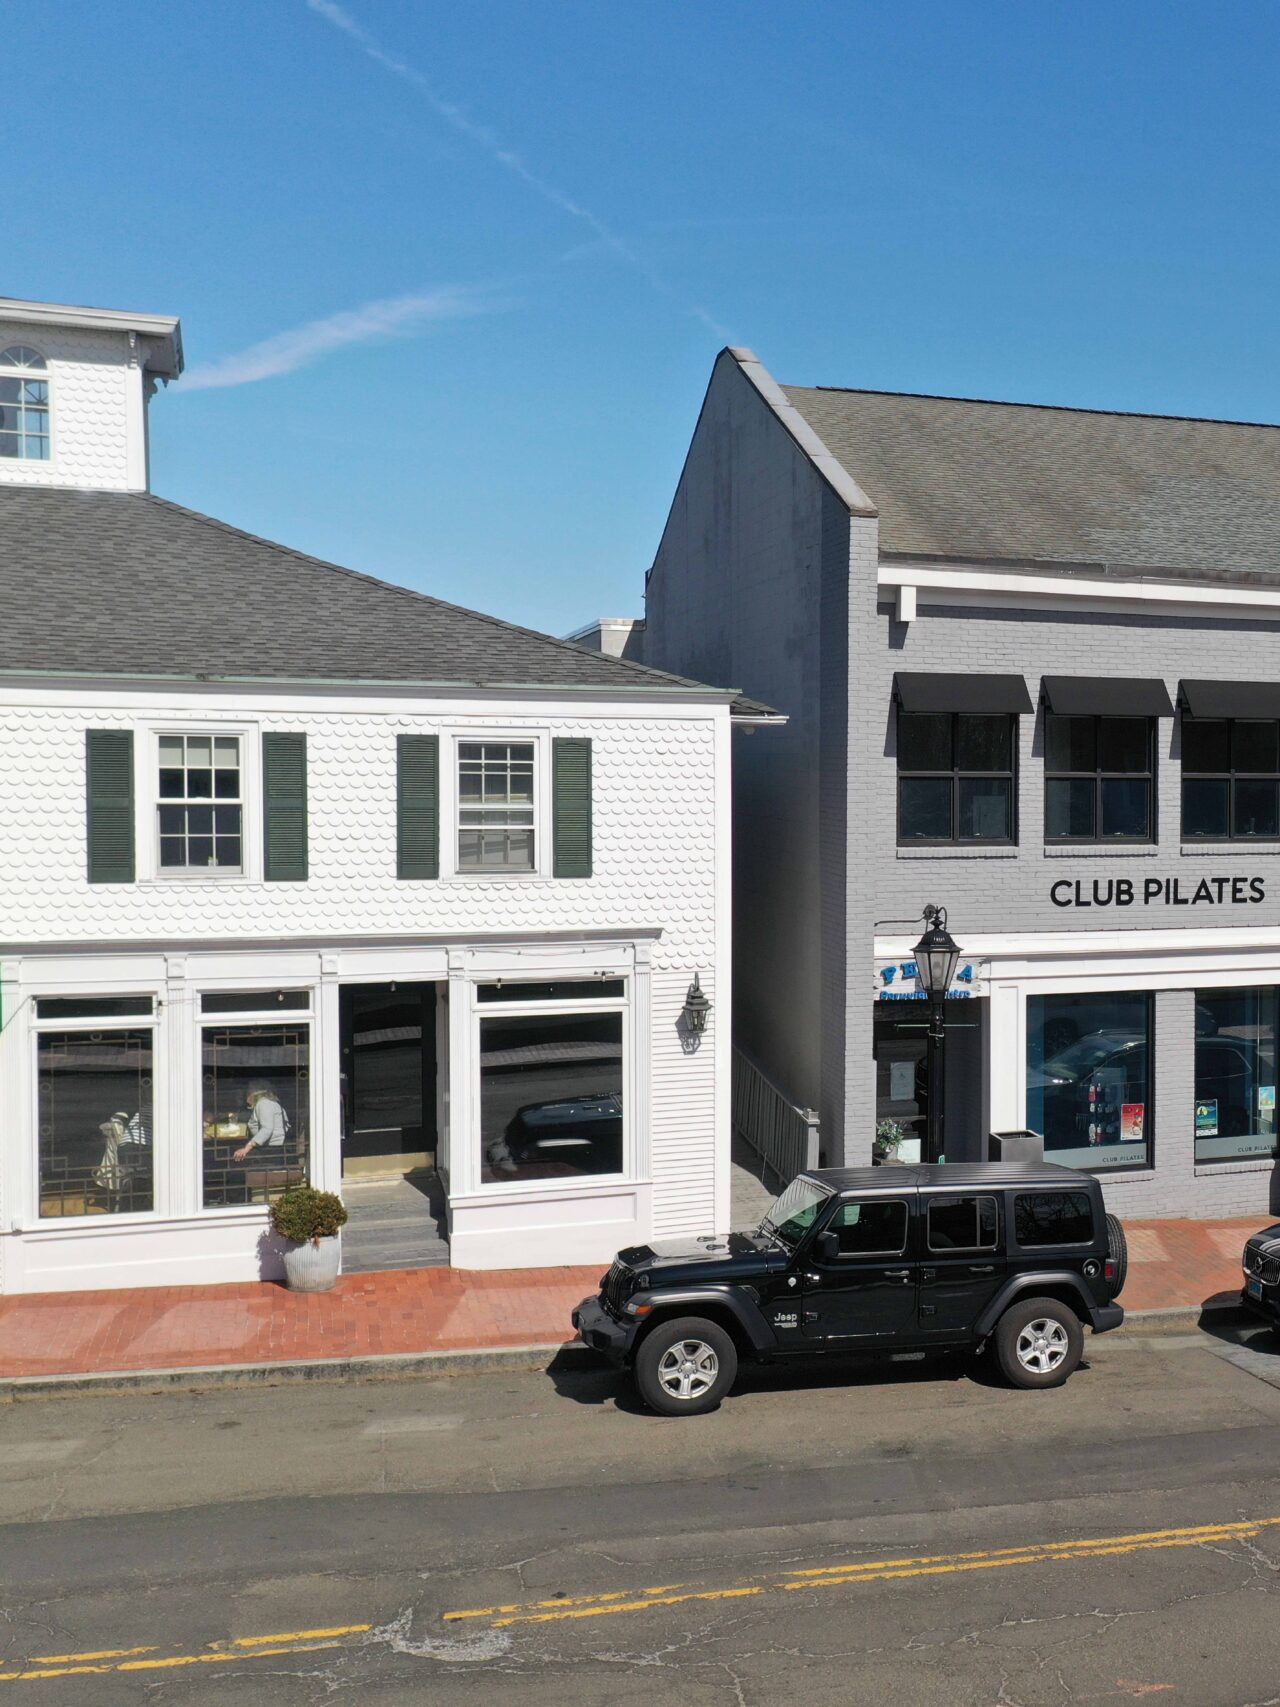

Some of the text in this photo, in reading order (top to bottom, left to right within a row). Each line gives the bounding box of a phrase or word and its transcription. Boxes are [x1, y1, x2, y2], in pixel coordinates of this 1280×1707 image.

[1050, 877, 1265, 907] CLUB PILATES
[774, 1312, 798, 1322] Jeep
